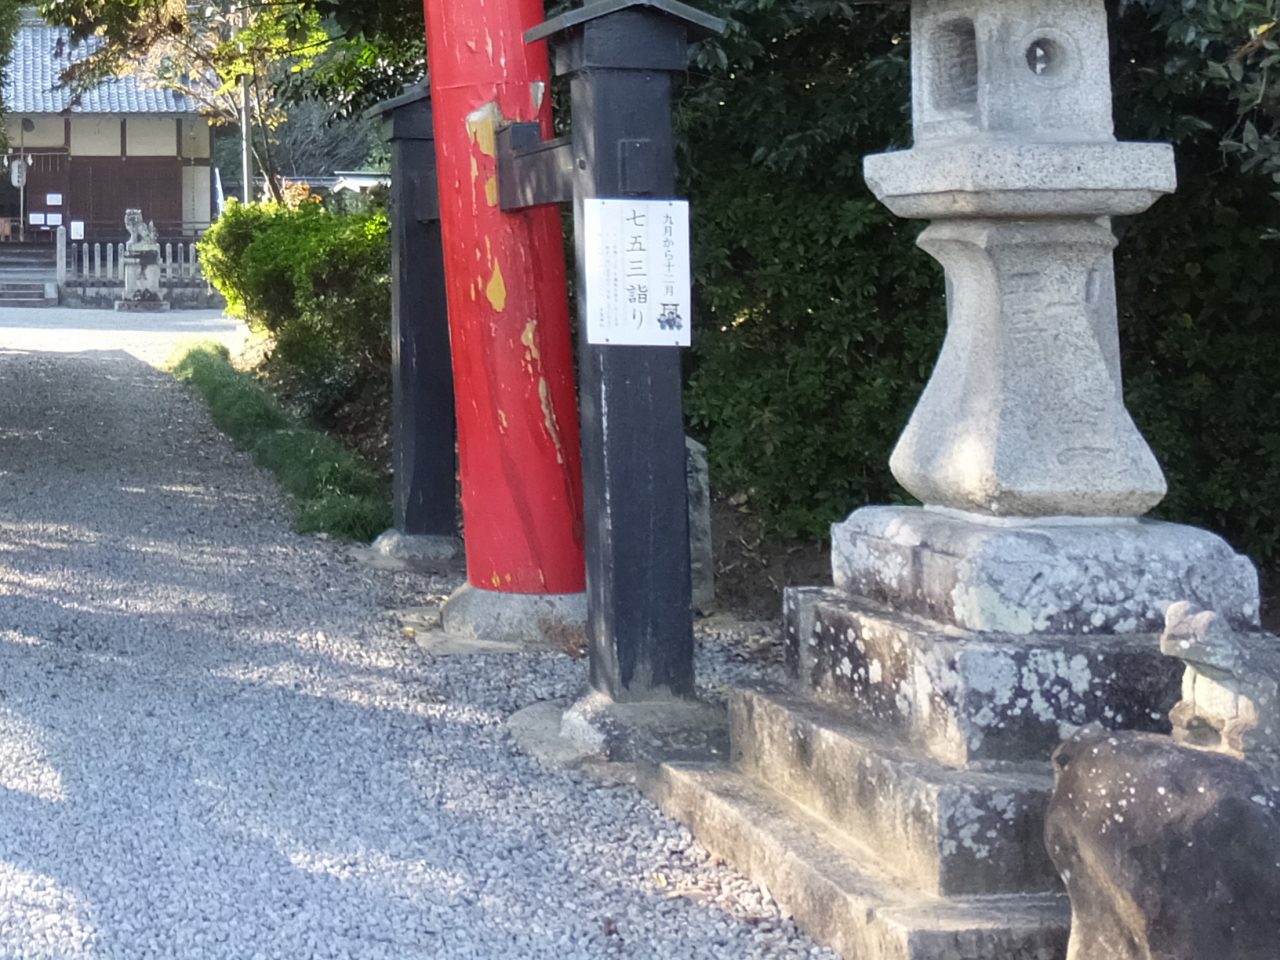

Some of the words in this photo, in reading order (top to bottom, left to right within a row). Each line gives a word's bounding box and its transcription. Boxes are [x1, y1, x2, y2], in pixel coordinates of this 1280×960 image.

[626, 209, 648, 330] 七五三詣り
[663, 213, 675, 297] 九月から十二月
